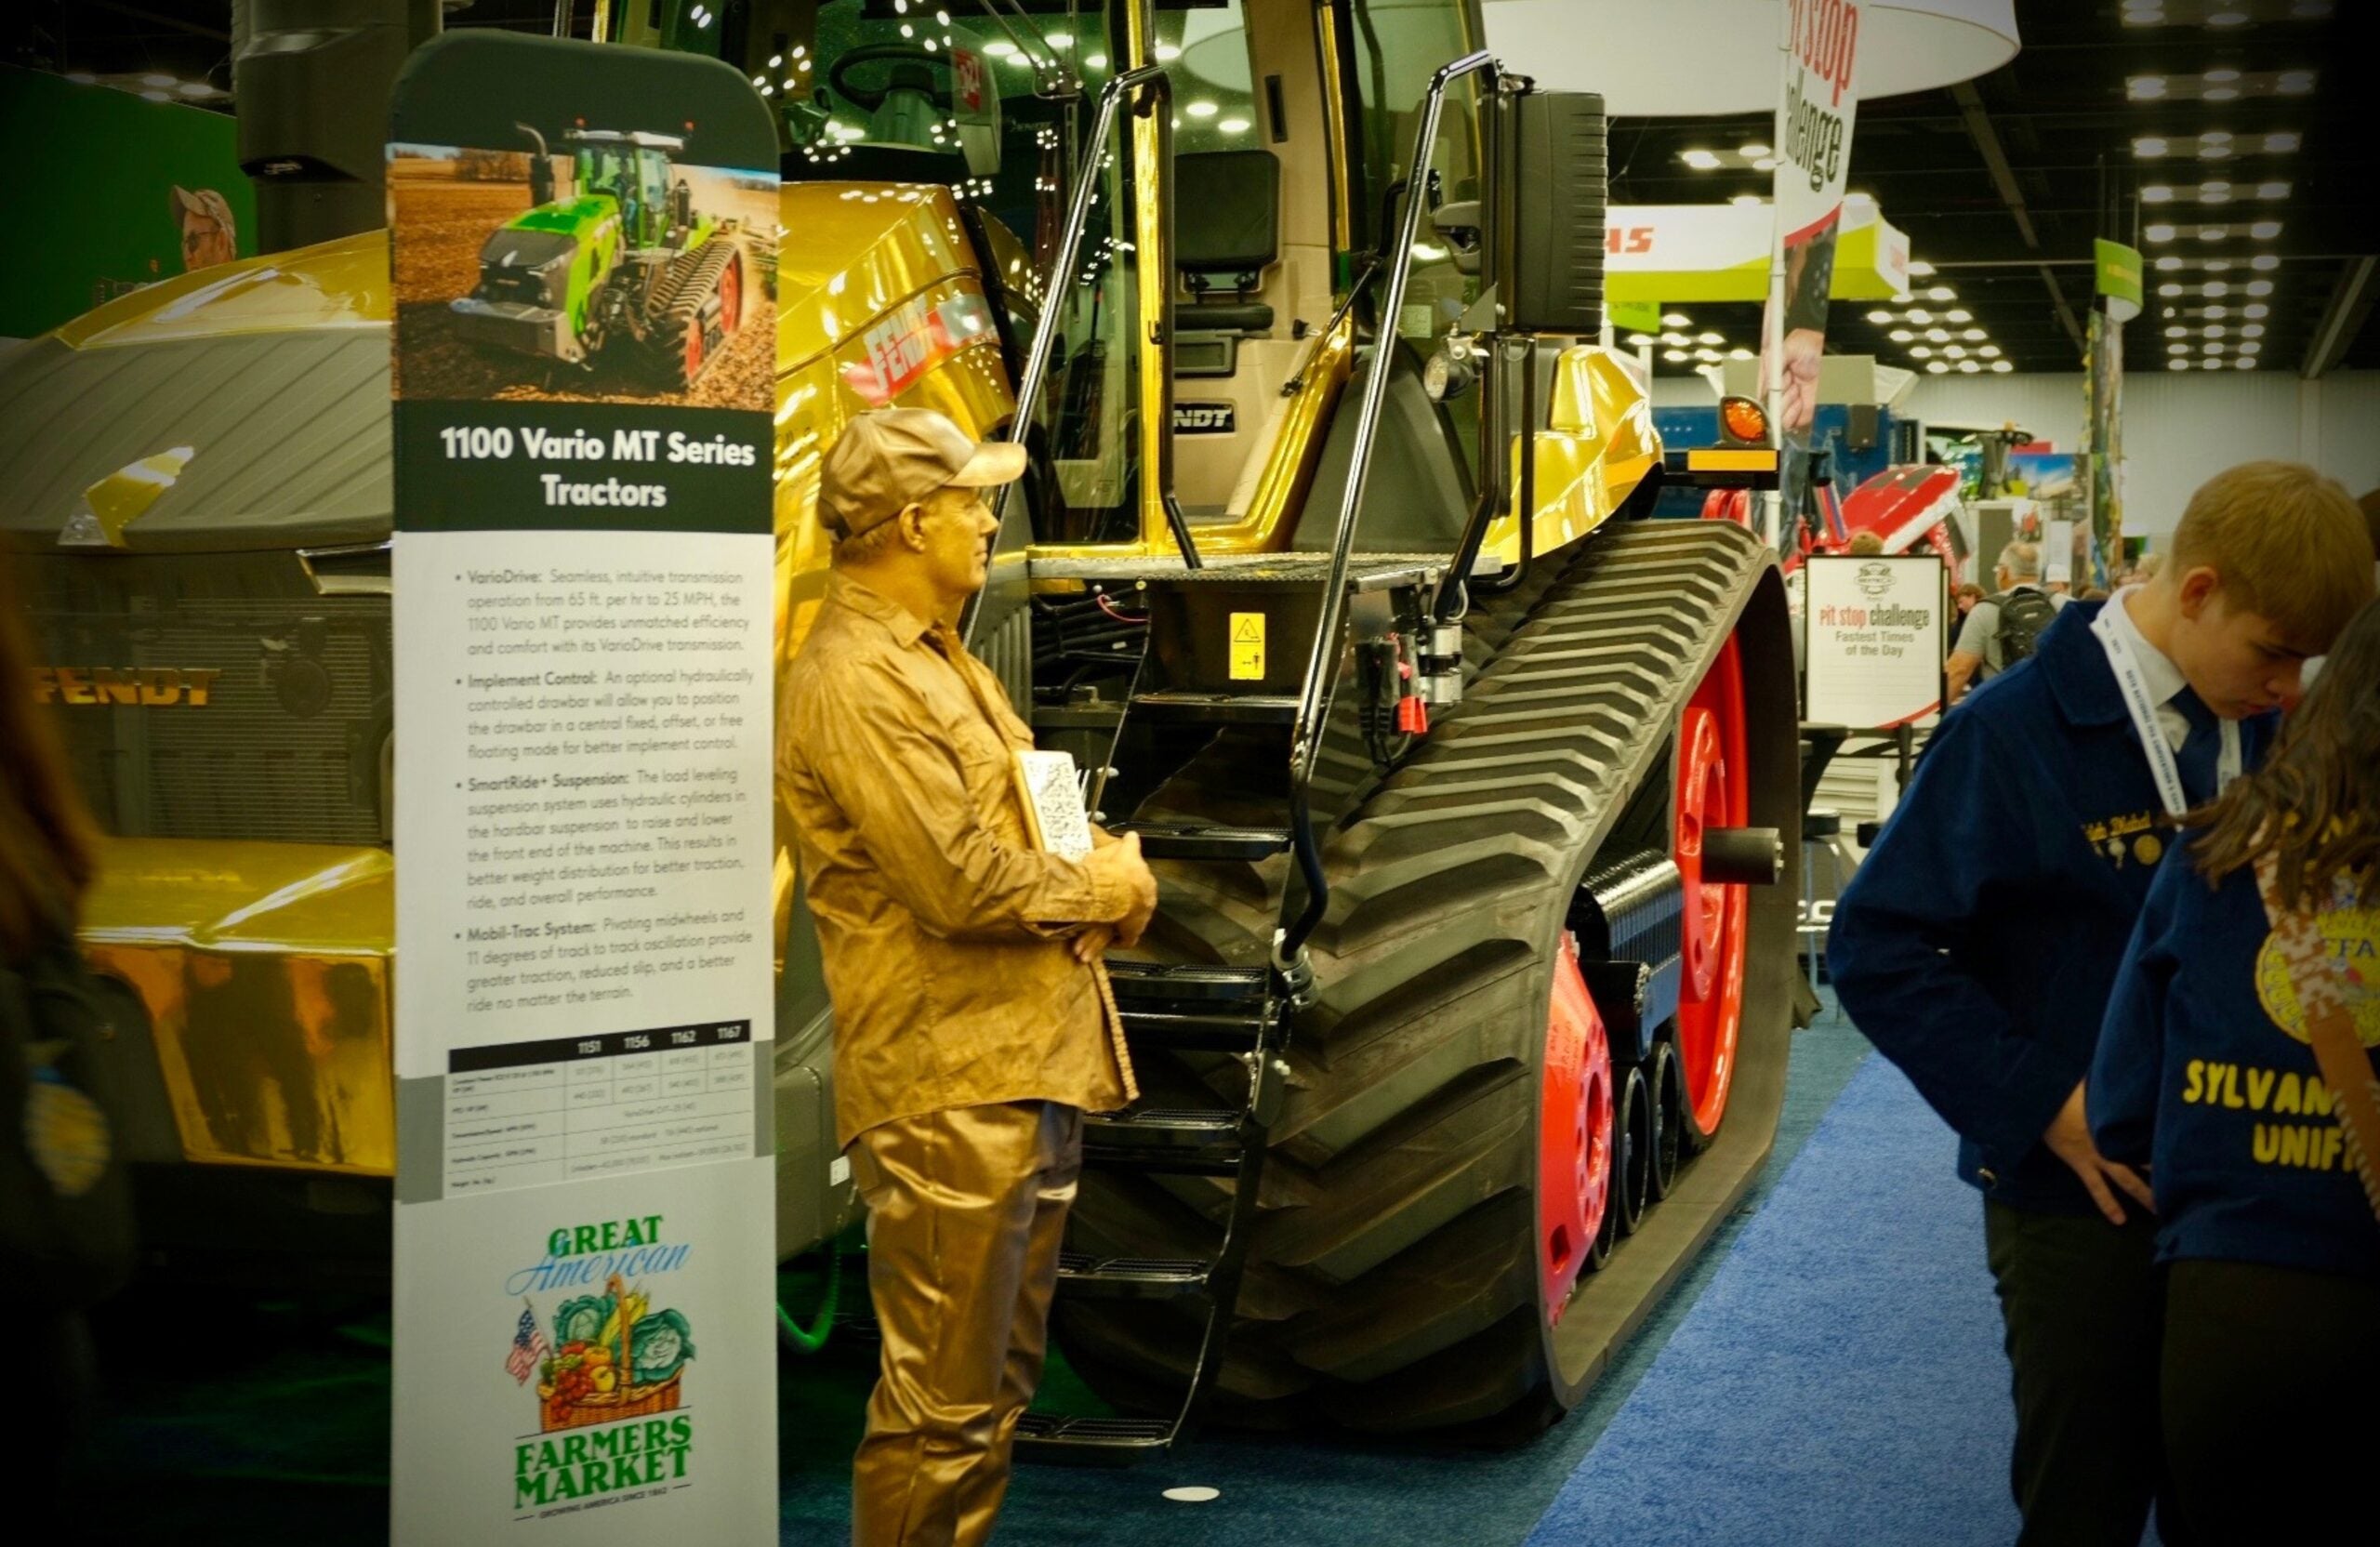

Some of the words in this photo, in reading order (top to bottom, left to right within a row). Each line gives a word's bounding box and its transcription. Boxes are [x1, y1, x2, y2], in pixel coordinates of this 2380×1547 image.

[441, 427, 513, 459] 1100
[521, 427, 605, 461] Vario
[613, 430, 660, 461] MT
[668, 431, 756, 467] Series
[540, 473, 668, 508] Tractors
[469, 571, 541, 583] VarioDrive:
[550, 571, 611, 584] Seamless,
[616, 571, 664, 583] intuitive
[668, 571, 742, 583] transmission
[469, 594, 531, 610] operation
[535, 593, 564, 605] from
[568, 593, 585, 605] 65
[606, 597, 627, 609] per
[630, 593, 643, 605] hr
[647, 593, 660, 605] to
[664, 593, 680, 605] 25
[721, 592, 740, 604] the
[469, 617, 497, 629] 1100
[502, 616, 535, 628] Vario
[539, 616, 560, 628] MT
[563, 616, 615, 632] provides
[620, 616, 689, 628] unmatched
[693, 615, 749, 632] efficiency
[1840, 606, 1866, 629] stop
[1870, 603, 1930, 630] challenge
[469, 641, 494, 653] and
[497, 641, 548, 653] comfort
[552, 640, 577, 652] with
[581, 640, 596, 652] its
[601, 639, 663, 652] VarioDrive
[668, 638, 743, 651] transmission.
[1835, 630, 1877, 642] Fastest
[1881, 630, 1915, 643] Times
[1844, 644, 1858, 655] of
[1860, 644, 1879, 655] the
[1882, 644, 1904, 658] Day
[31, 667, 221, 707] FENDT
[469, 673, 540, 691] Implement
[545, 672, 597, 685] Control:
[606, 672, 622, 684] An
[627, 671, 676, 688] optional
[681, 669, 753, 687] hydraulically
[469, 696, 534, 710] controlled
[537, 695, 590, 708] drawbar
[594, 694, 613, 707] will
[617, 694, 649, 707] allow
[652, 697, 673, 709] you
[677, 693, 689, 705] to
[693, 692, 740, 708] position
[469, 721, 489, 734] the
[494, 720, 547, 734] drawbar
[551, 719, 562, 732] in
[566, 722, 574, 731] a
[578, 717, 622, 731] central
[627, 716, 658, 730] fixed,
[704, 718, 716, 726] or
[720, 713, 743, 726] free
[469, 744, 519, 761] floating
[523, 742, 558, 755] mode
[562, 742, 579, 754] for
[584, 740, 622, 753] better
[627, 738, 690, 756] implement
[469, 775, 548, 790] SmartRide+
[553, 773, 629, 791] Suspension:
[637, 772, 658, 784] The
[662, 771, 688, 783] load
[692, 769, 737, 787] leveling
[469, 800, 539, 818] suspension
[544, 797, 587, 815] system
[591, 800, 618, 809] uses
[622, 793, 675, 812] hydraulic
[681, 790, 732, 809] cylinders
[735, 789, 746, 802] in
[469, 825, 489, 837] the
[550, 818, 619, 838] suspension
[626, 817, 639, 829] to
[642, 815, 671, 829] raise
[675, 814, 697, 827] and
[702, 813, 732, 826] lower
[469, 848, 489, 861] the
[494, 846, 524, 859] front
[529, 844, 553, 857] end
[558, 843, 571, 856] of
[574, 842, 595, 855] the
[599, 840, 653, 854] machine.
[657, 838, 681, 851] This
[684, 836, 723, 850] results
[727, 835, 737, 848] in
[468, 870, 508, 884] better
[512, 867, 555, 886] weight
[559, 864, 629, 879] distribution
[633, 863, 649, 876] for
[654, 861, 690, 875] better
[694, 858, 744, 874] traction,
[468, 895, 496, 910] ride,
[500, 892, 525, 906] and
[530, 890, 573, 905] overall
[577, 884, 657, 906] performance.
[545, 919, 595, 940] System:
[603, 916, 651, 935] Pivoting
[655, 911, 718, 927] midwheels
[721, 908, 744, 922] and
[483, 946, 536, 966] degrees
[541, 945, 554, 959] of
[558, 943, 590, 957] track
[594, 942, 606, 955] to
[610, 939, 641, 953] track
[643, 934, 705, 951] oscillation
[708, 932, 751, 950] provide
[468, 972, 515, 992] greater
[520, 967, 576, 985] traction,
[580, 963, 628, 979] reduced
[660, 959, 683, 972] and
[687, 960, 694, 970] a
[699, 954, 734, 969] better
[468, 997, 492, 1011] ride
[496, 998, 512, 1009] no
[517, 991, 562, 1007] matter
[565, 989, 587, 1002] the
[577, 1039, 602, 1054] 1151
[624, 1035, 650, 1050] 1156
[671, 1029, 696, 1045] 1162
[717, 1025, 742, 1039] 1167
[549, 1215, 664, 1258] GREAT
[504, 1243, 693, 1296] American
[515, 1414, 692, 1475] FARMERS
[514, 1445, 692, 1510] MARKET
